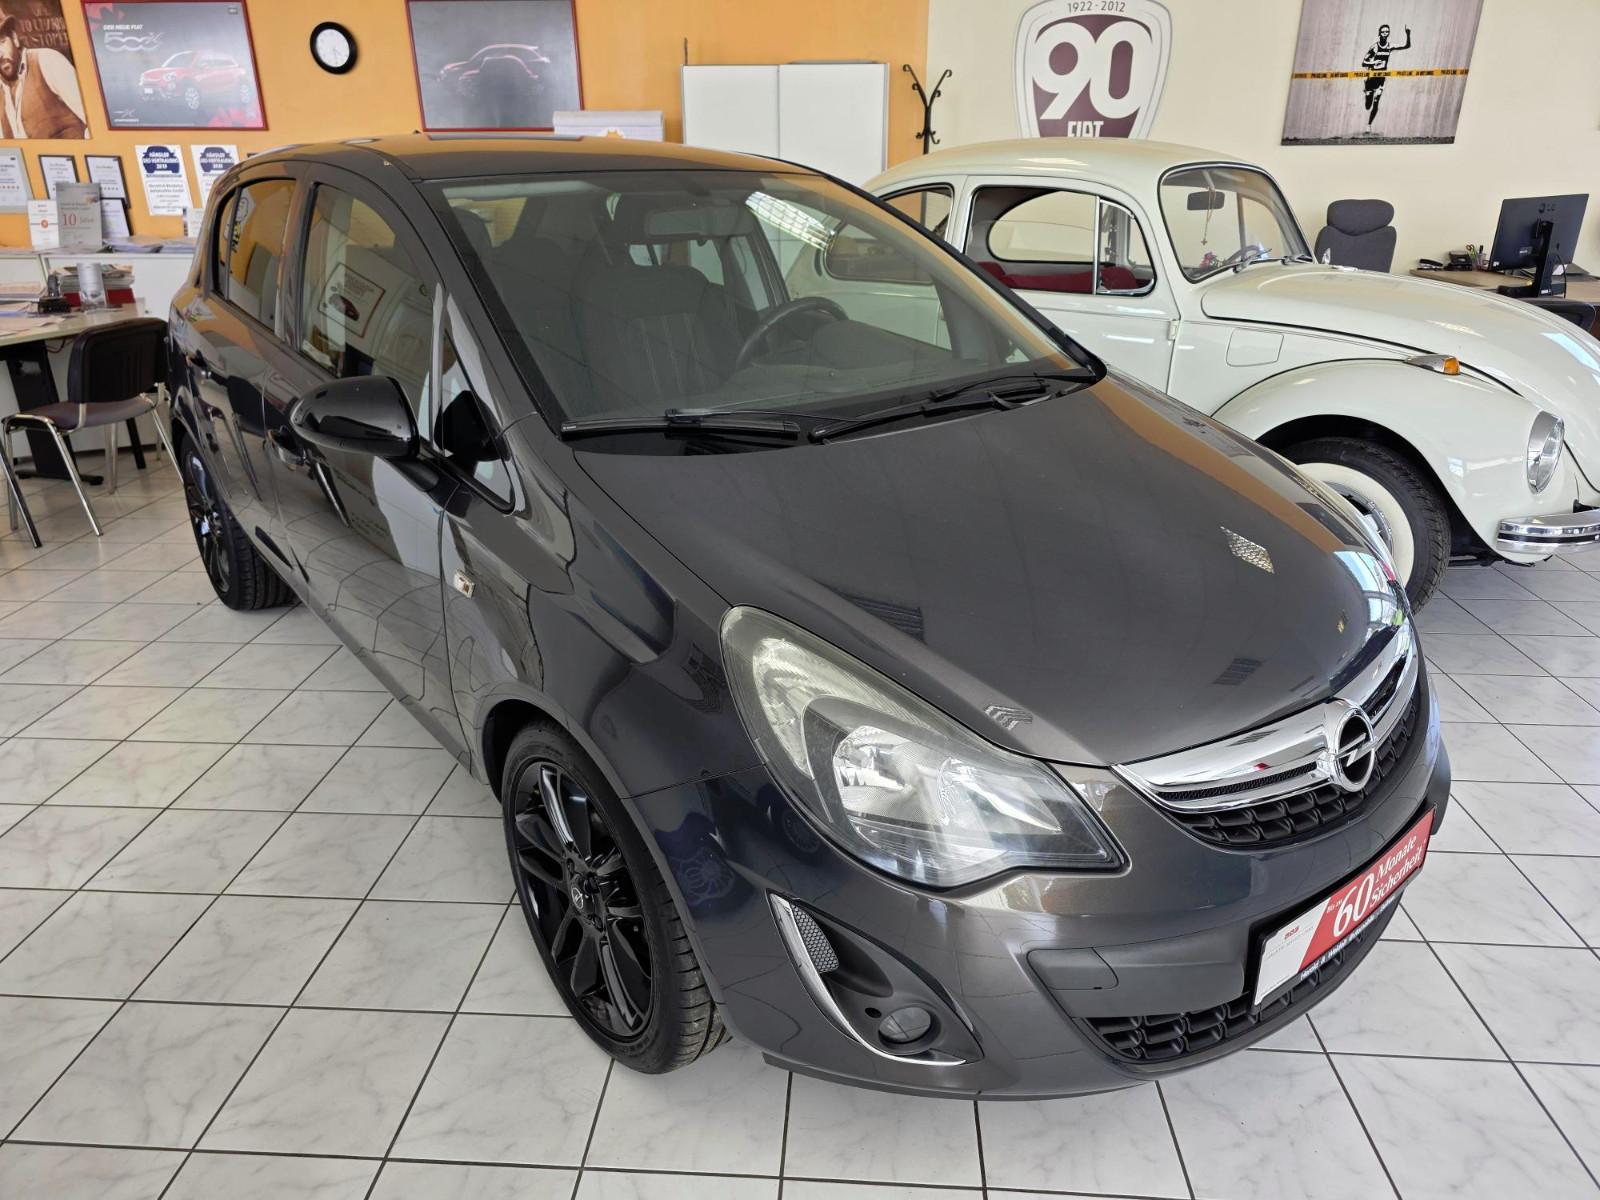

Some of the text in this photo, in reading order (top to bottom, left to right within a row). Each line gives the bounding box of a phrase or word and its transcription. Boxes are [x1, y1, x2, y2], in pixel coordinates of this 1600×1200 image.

[1068, 1, 1092, 13] 1922
[1101, 1, 1126, 12] 2012
[1032, 21, 1153, 120] 90
[1067, 121, 1104, 137] FIAT
[62, 214, 77, 225] 10
[1376, 835, 1417, 883] Monate
[1333, 873, 1375, 937] 60
